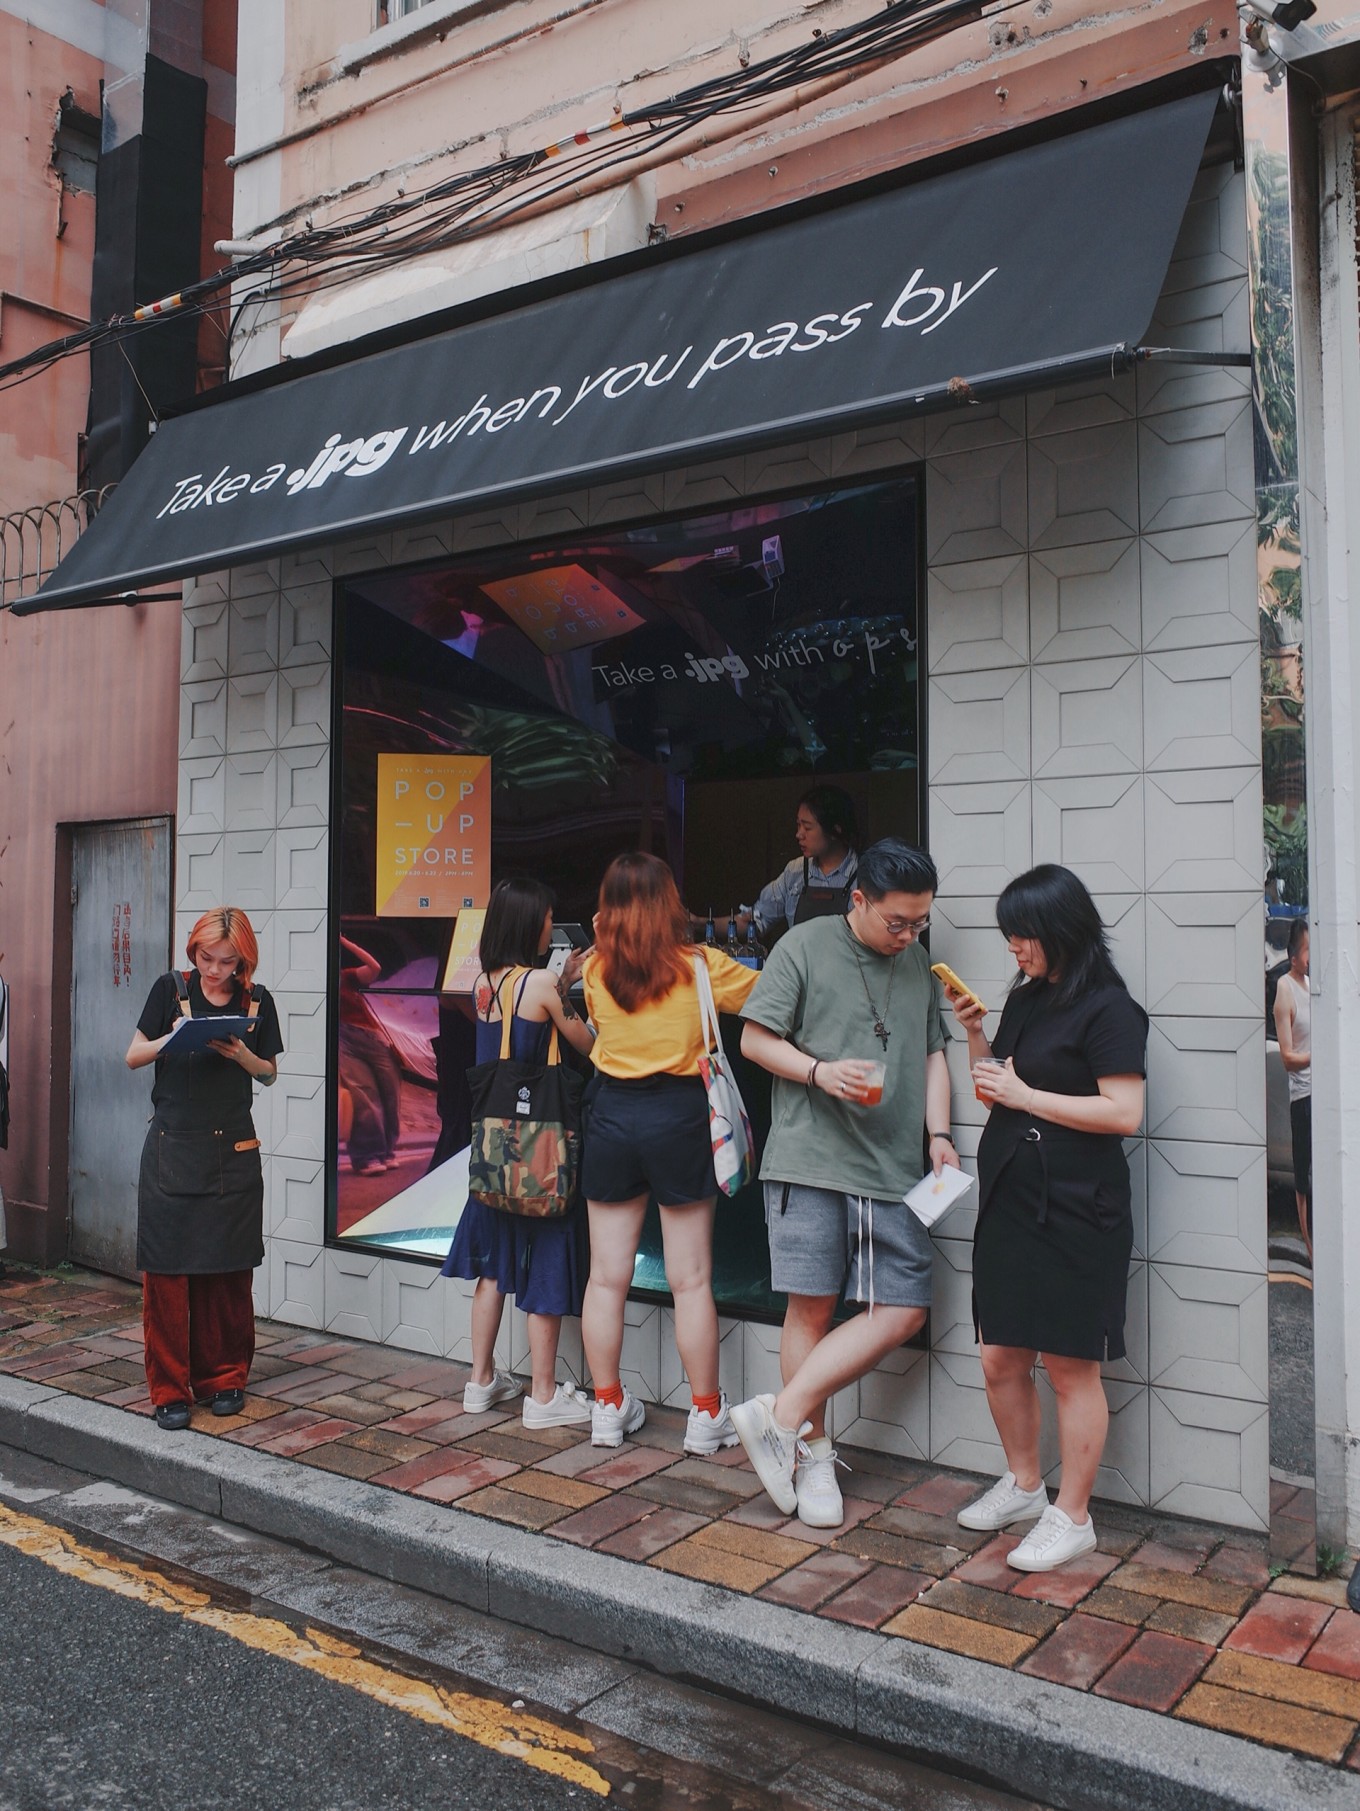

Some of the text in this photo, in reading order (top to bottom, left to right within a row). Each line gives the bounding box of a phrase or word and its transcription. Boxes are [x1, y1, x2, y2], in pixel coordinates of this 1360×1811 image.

[156, 266, 999, 519] Take a .jpg when you pass by
[591, 661, 656, 688] Take
[660, 664, 678, 680] a
[684, 652, 750, 683] .jpg
[753, 639, 825, 671] with
[395, 780, 475, 801] POP
[395, 848, 474, 865] STORE
